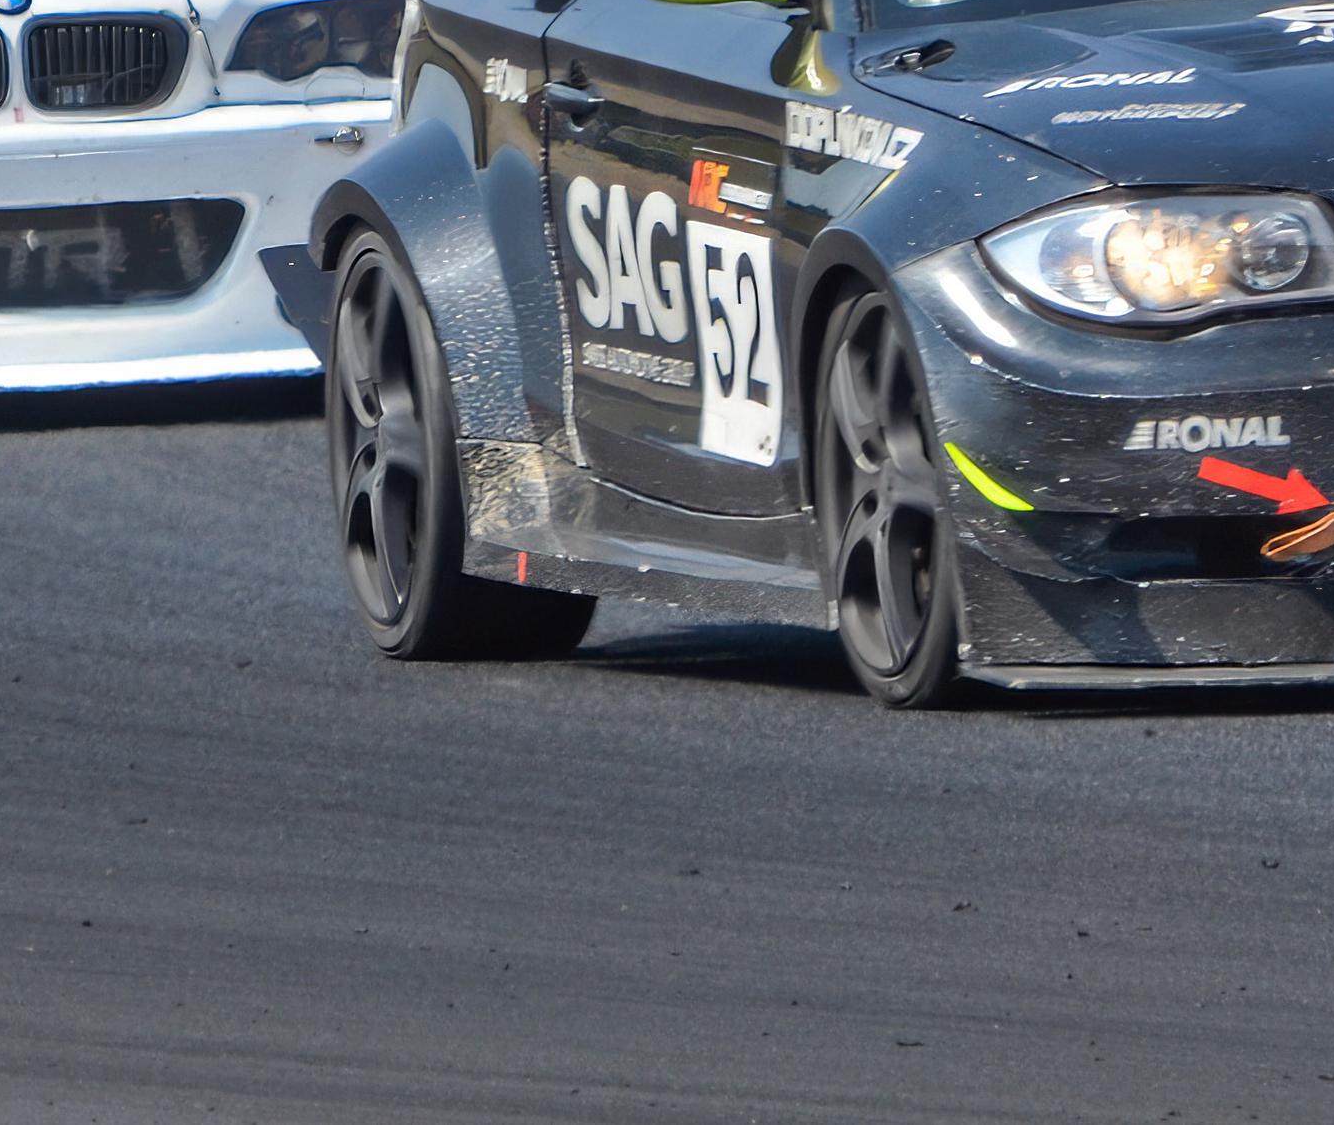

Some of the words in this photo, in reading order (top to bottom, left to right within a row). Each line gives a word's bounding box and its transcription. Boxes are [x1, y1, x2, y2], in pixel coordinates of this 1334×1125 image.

[1027, 67, 1198, 91] RONAL
[566, 175, 689, 344] SAG
[703, 243, 771, 409] 52
[1156, 415, 1291, 453] RONAL
